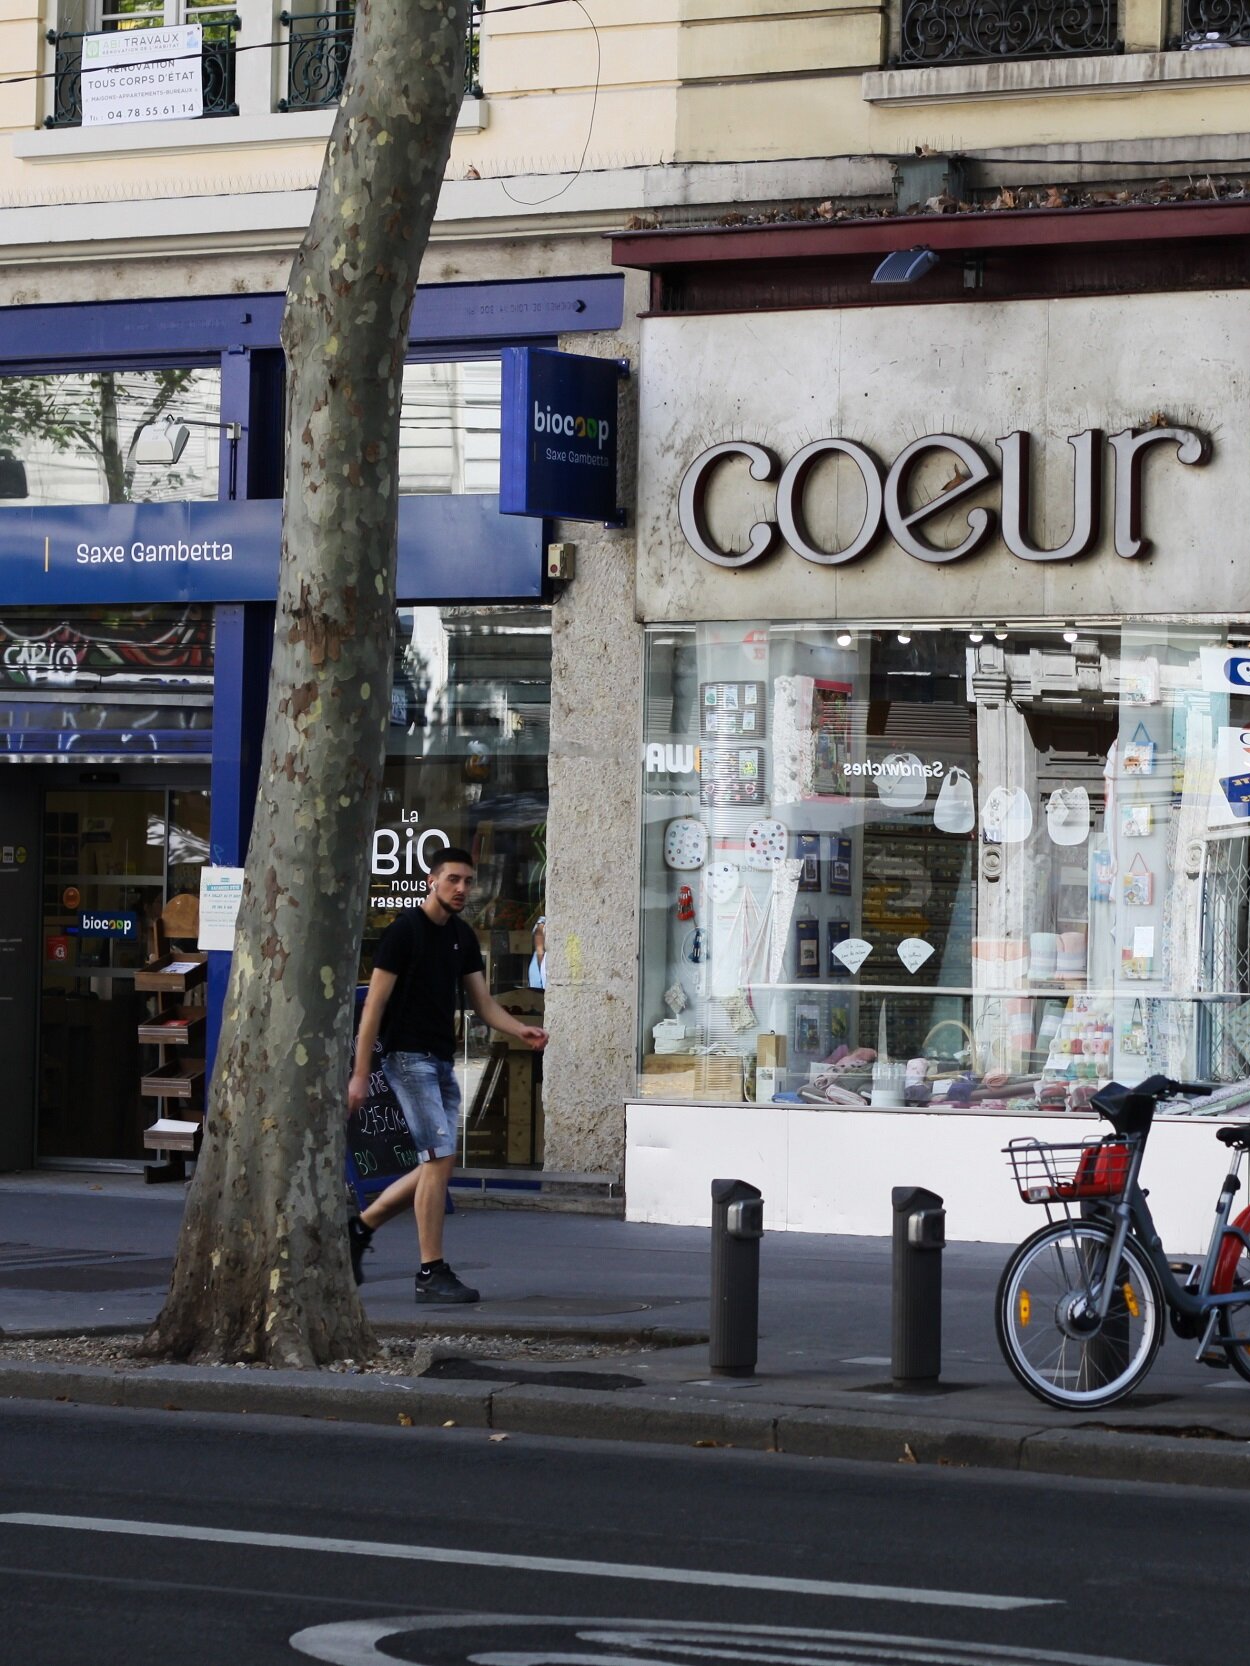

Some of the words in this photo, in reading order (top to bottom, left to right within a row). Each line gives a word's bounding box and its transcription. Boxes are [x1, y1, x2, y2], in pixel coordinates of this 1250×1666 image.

[124, 33, 180, 47] TRAVAUX
[88, 78, 117, 89] TOUS
[119, 74, 155, 87] CORPS
[158, 71, 195, 83] D'ÉTAT
[534, 400, 609, 450] biocoop
[545, 447, 567, 462] Saxe
[568, 450, 609, 467] Gambetta
[678, 428, 1213, 568] coeur
[76, 543, 125, 564] Saxe
[131, 540, 233, 562] Gambetta
[401, 808, 419, 823] La
[391, 880, 427, 892] nous
[370, 896, 427, 908] rassem
[82, 914, 132, 935] biocoop
